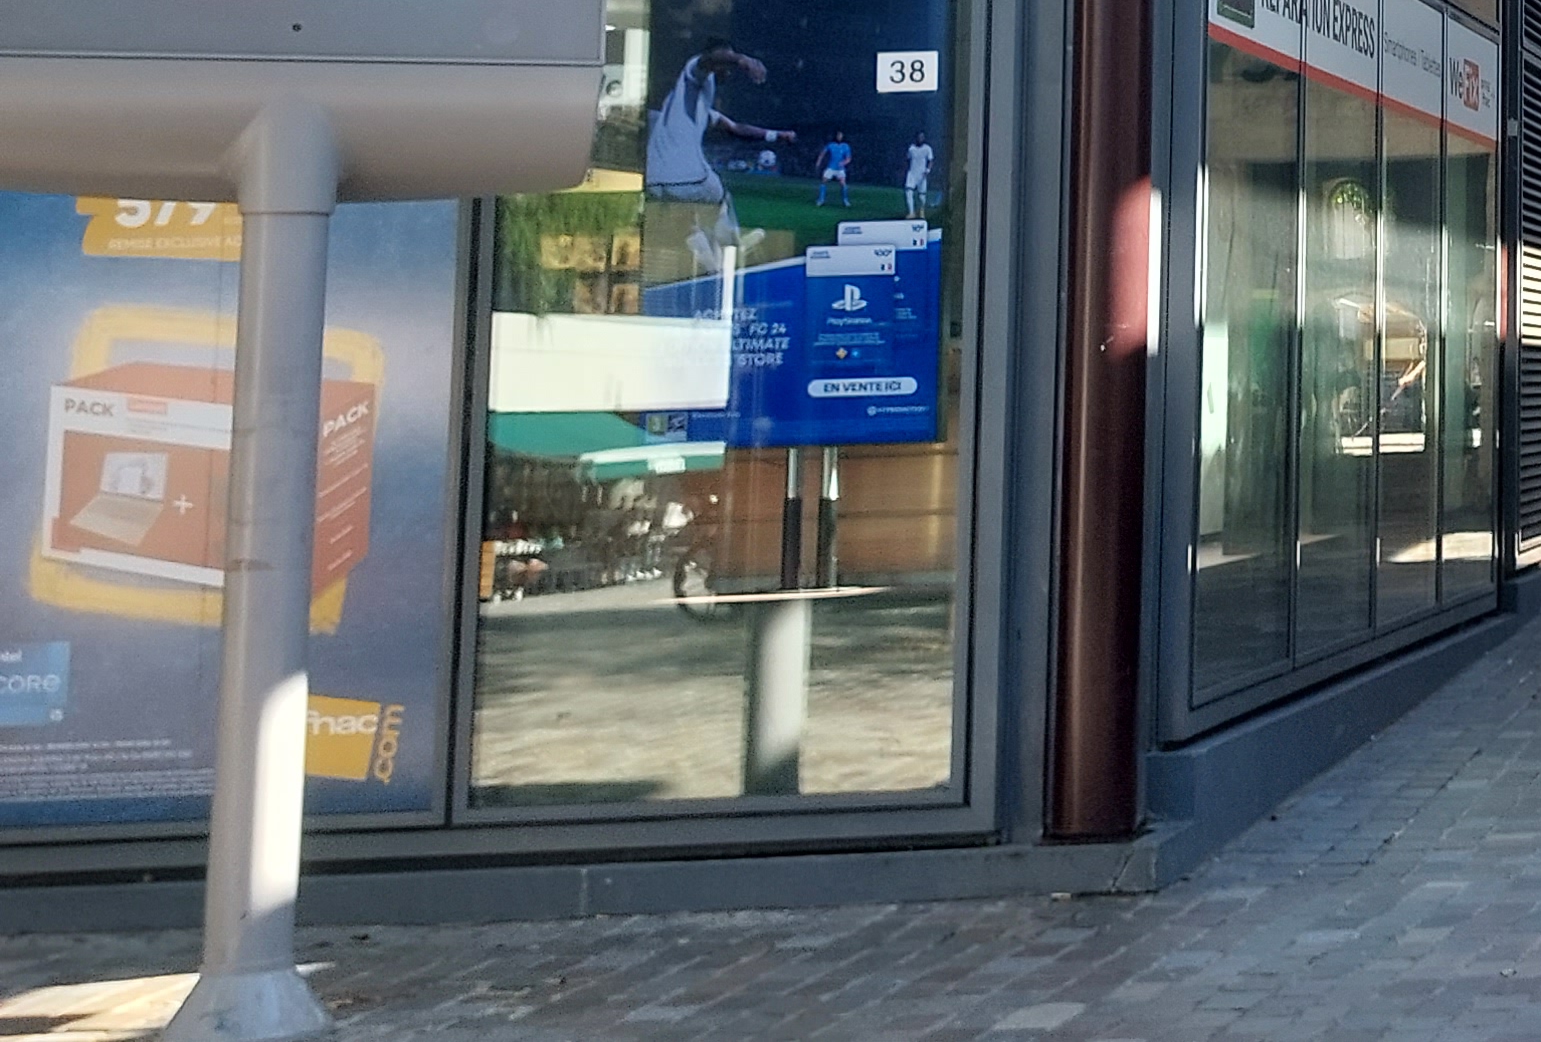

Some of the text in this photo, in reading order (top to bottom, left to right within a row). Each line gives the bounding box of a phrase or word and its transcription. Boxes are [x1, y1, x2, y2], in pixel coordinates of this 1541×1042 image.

[889, 60, 926, 85] 38
[824, 381, 902, 393] EN VENTE ICI
[64, 397, 115, 418] PACK
[322, 400, 369, 438] PACK
